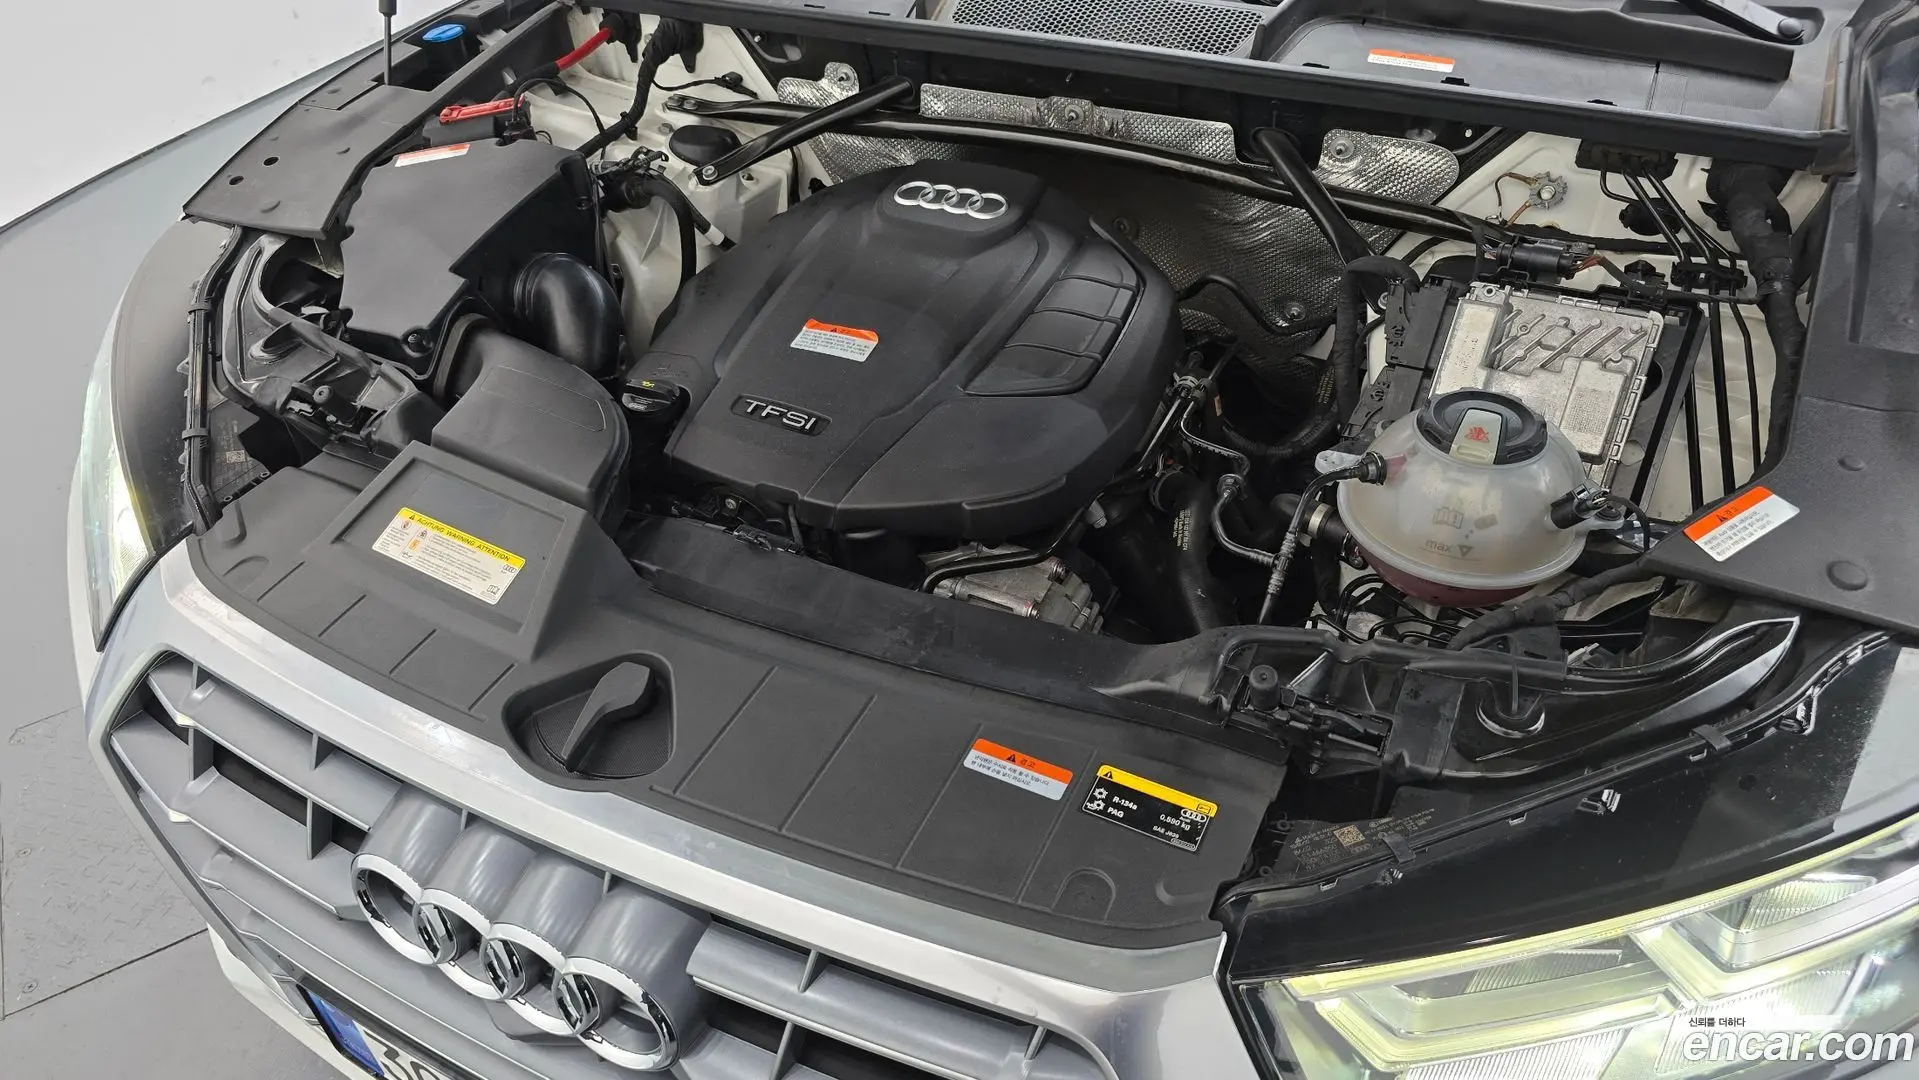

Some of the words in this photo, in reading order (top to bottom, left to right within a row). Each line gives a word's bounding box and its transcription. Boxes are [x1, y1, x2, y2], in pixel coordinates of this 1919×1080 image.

[746, 399, 816, 430] TFSI
[417, 517, 445, 533] ACHTUNG
[446, 530, 475, 546] WARNING
[477, 543, 511, 562] ATTENTION
[1425, 539, 1452, 553] max
[1112, 795, 1138, 810] R-134a
[1107, 806, 1125, 818] PAG
[1180, 822, 1191, 831] kg
